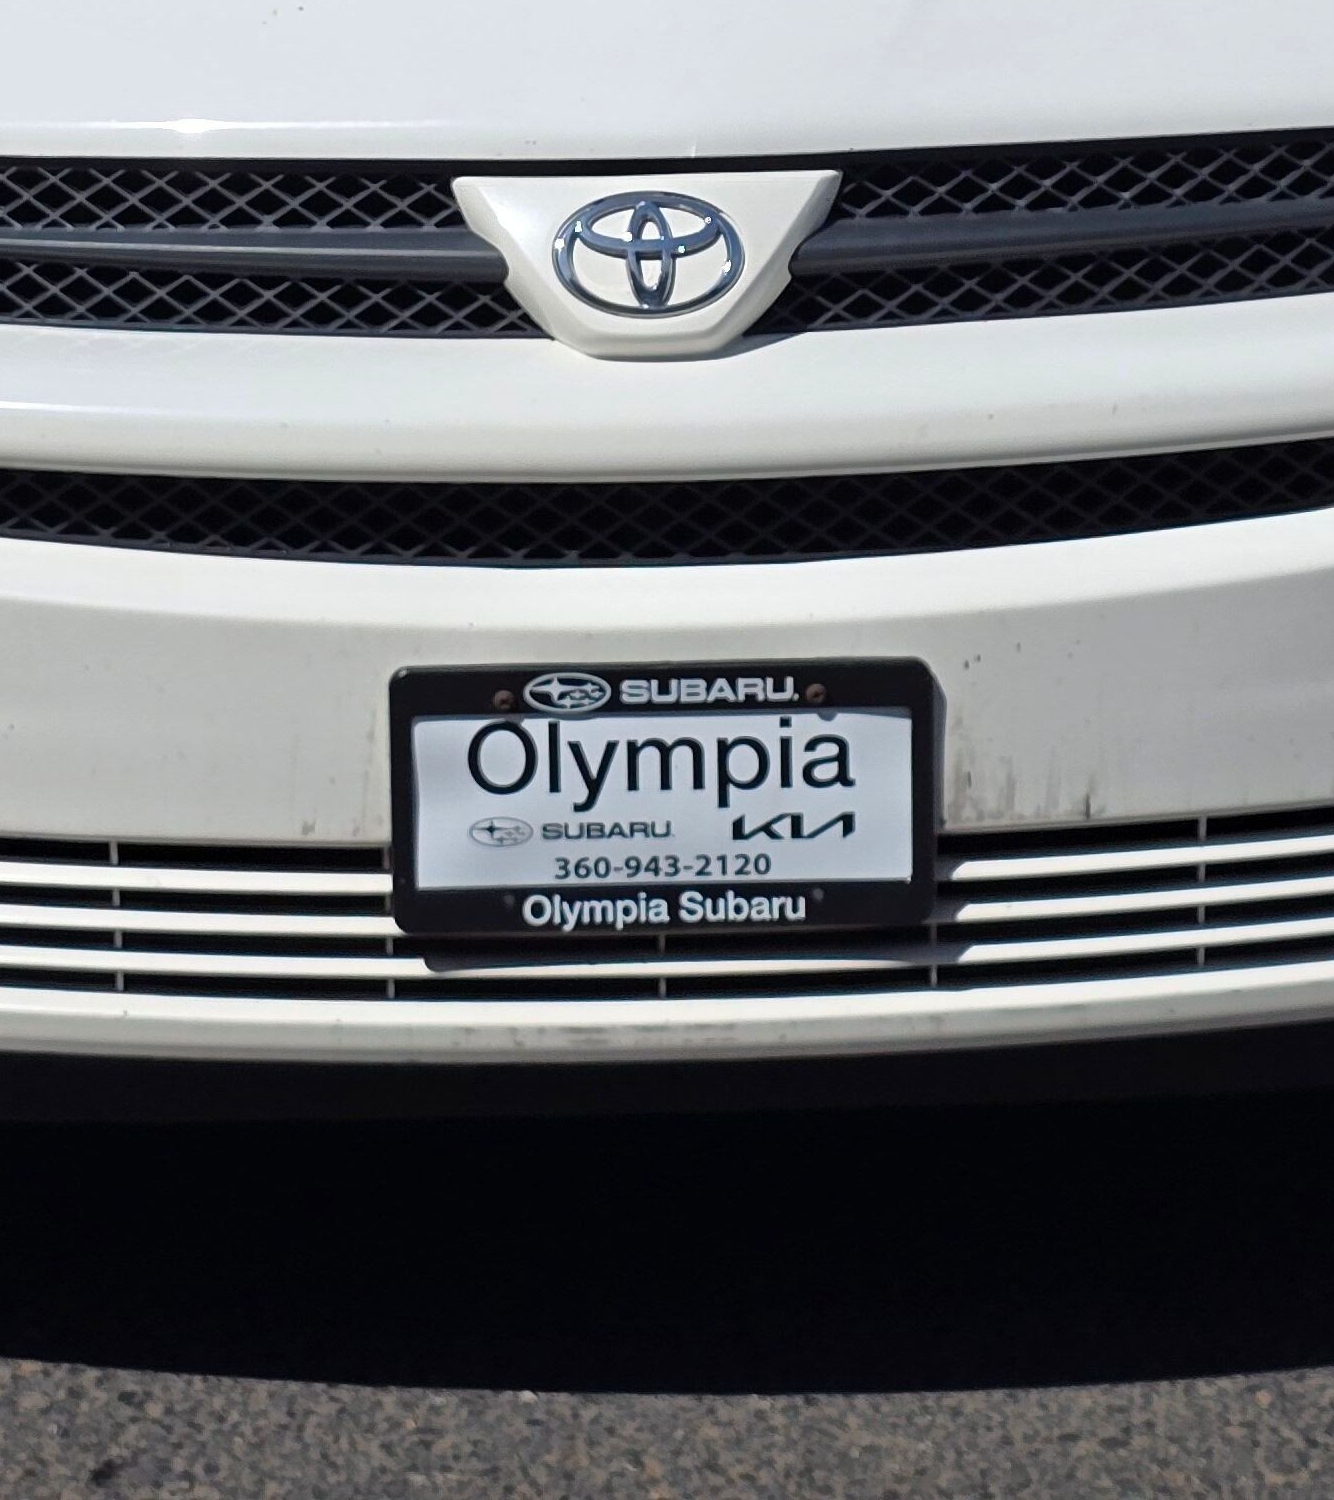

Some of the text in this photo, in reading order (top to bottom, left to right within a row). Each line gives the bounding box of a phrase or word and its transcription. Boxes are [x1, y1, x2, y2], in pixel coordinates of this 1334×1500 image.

[468, 716, 856, 813] Olympia
[542, 821, 671, 841] SUBARU
[732, 811, 856, 841] KIA
[554, 853, 772, 880] 360-943-2120
[522, 889, 807, 933] Olympia Subaru
